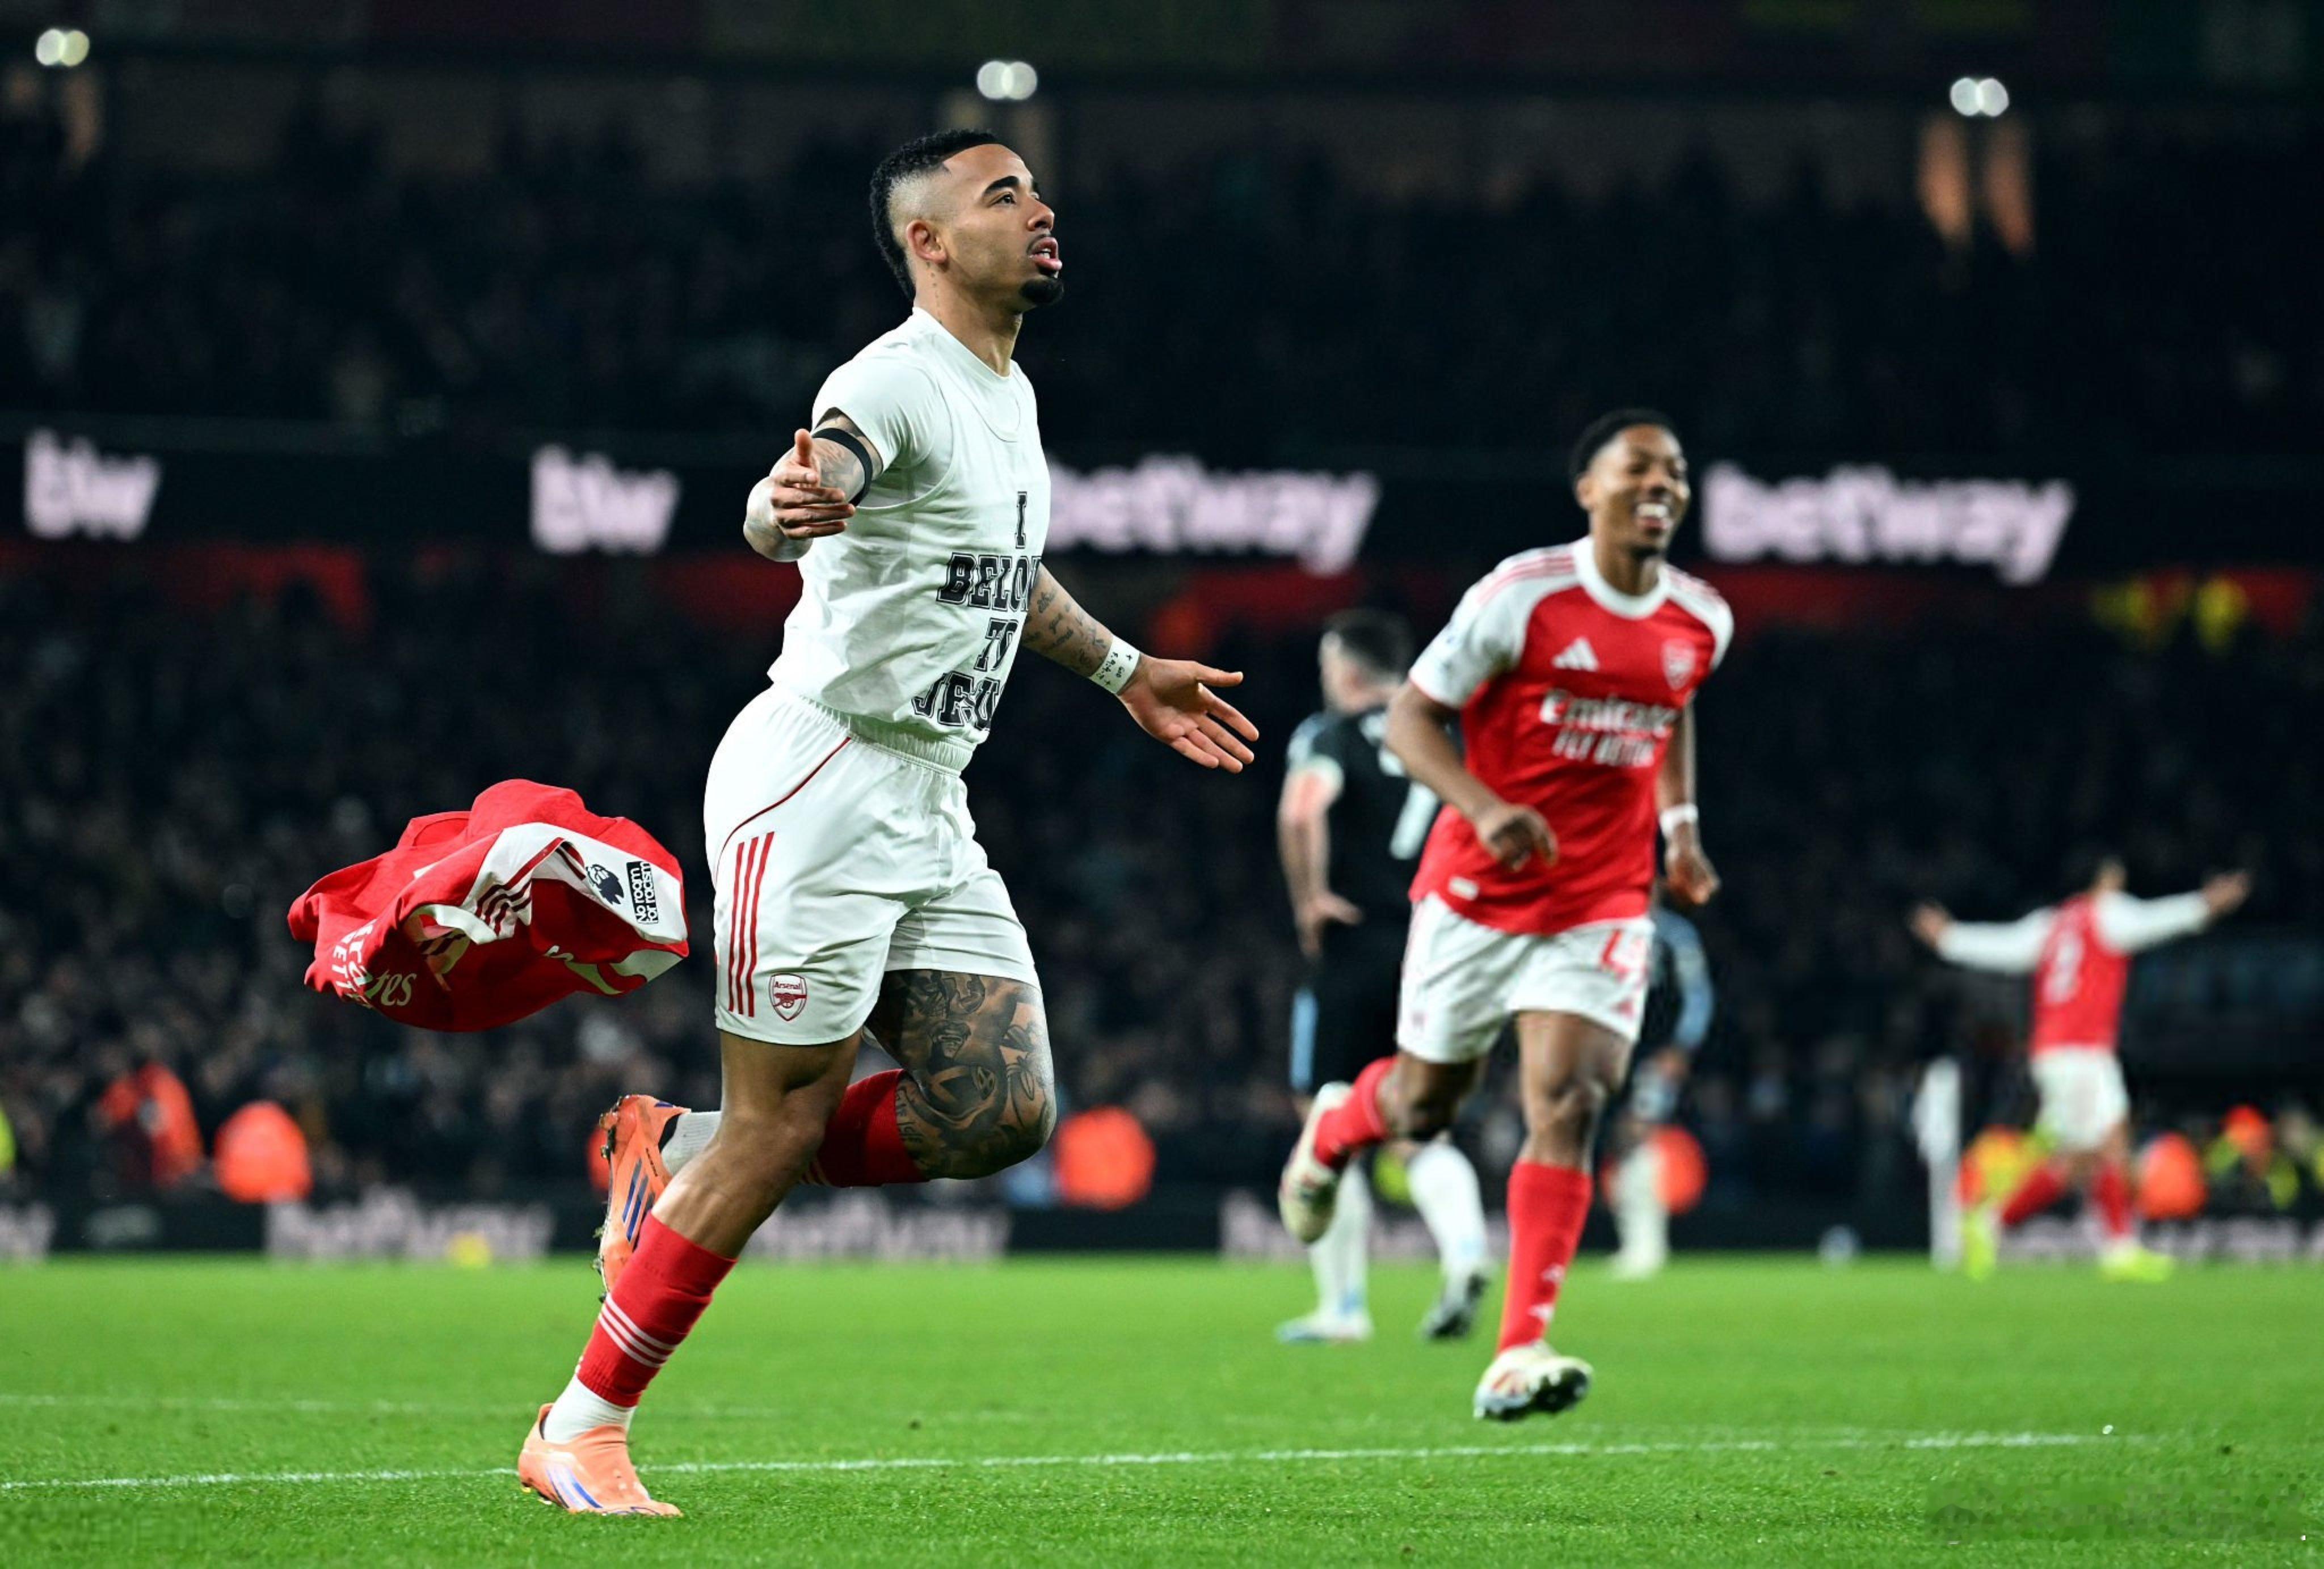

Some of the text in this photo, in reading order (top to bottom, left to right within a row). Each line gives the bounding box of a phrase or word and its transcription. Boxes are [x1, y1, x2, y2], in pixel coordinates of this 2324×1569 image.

[1046, 457, 1378, 576] etway
[1703, 465, 2072, 583] betway
[630, 867, 647, 923] No room
[639, 862, 656, 904] racism
[774, 981, 801, 990] Arsenal
